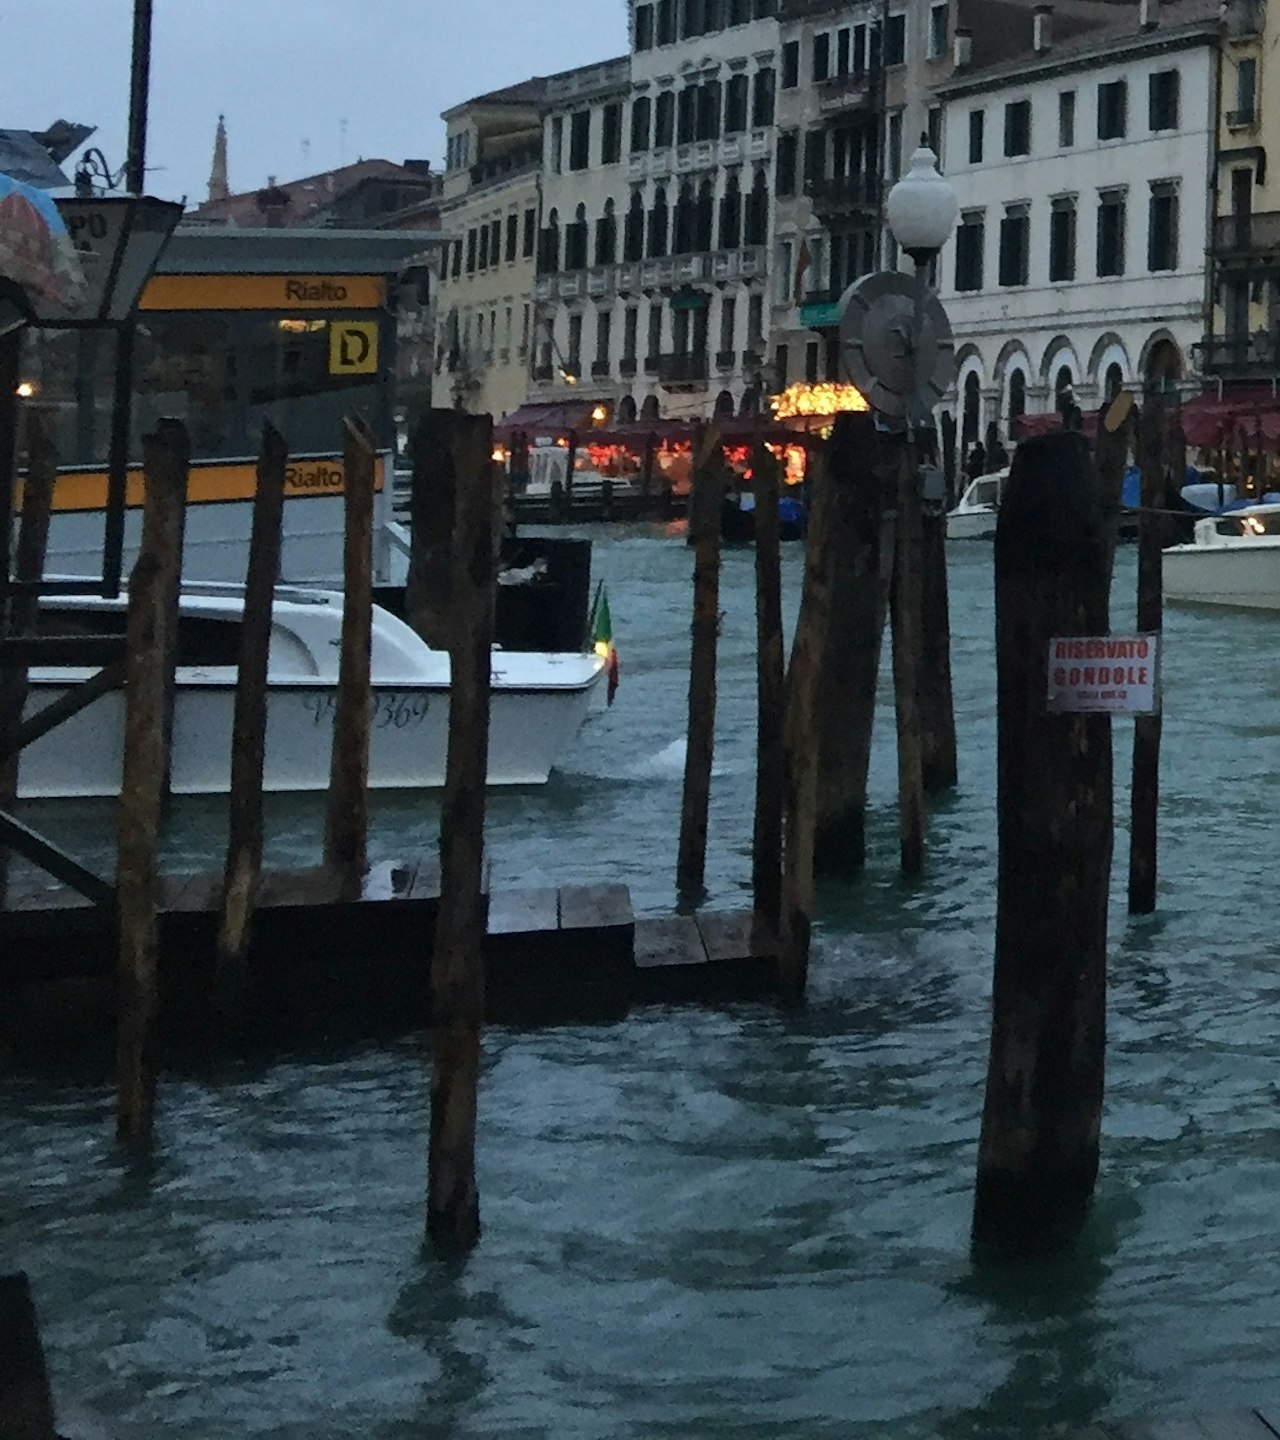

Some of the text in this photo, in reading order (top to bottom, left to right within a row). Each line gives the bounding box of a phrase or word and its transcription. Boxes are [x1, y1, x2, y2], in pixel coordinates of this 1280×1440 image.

[285, 279, 348, 301] Rialto
[340, 328, 370, 366] D
[284, 467, 343, 488] Rialto
[1056, 639, 1149, 659] RISERVATO
[1054, 666, 1148, 686] GONDOLE
